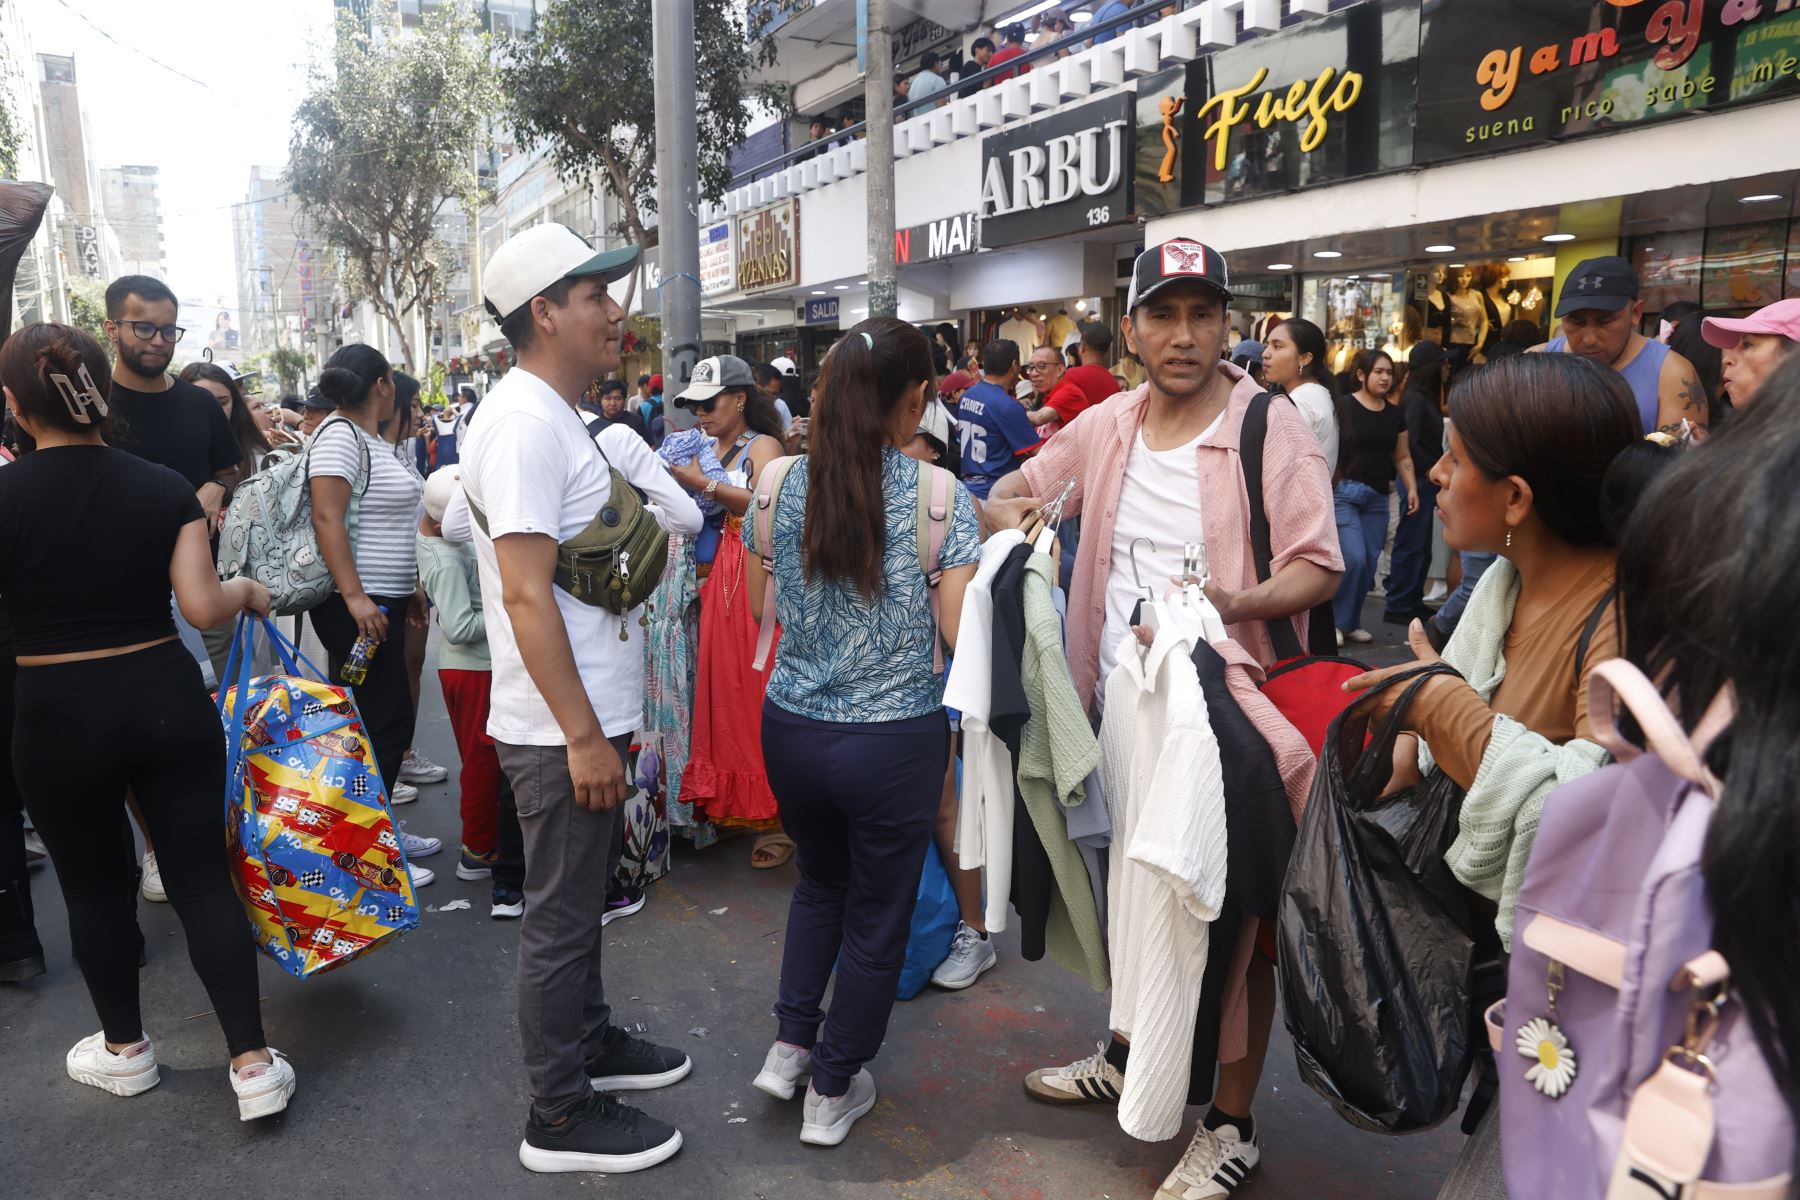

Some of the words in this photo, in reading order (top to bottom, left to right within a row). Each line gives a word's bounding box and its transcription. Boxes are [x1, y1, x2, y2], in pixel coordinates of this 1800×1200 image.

[1645, 0, 1800, 71] ya
[1197, 66, 1363, 171] Fuego
[1465, 116, 1534, 143] suena
[1561, 99, 1614, 124] rico
[1646, 74, 1716, 106] sabe
[1751, 56, 1800, 83] me
[975, 119, 1128, 220] ARBU
[1086, 205, 1110, 226] 136
[957, 420, 988, 464] 76
[959, 397, 985, 416] CHAVEZ
